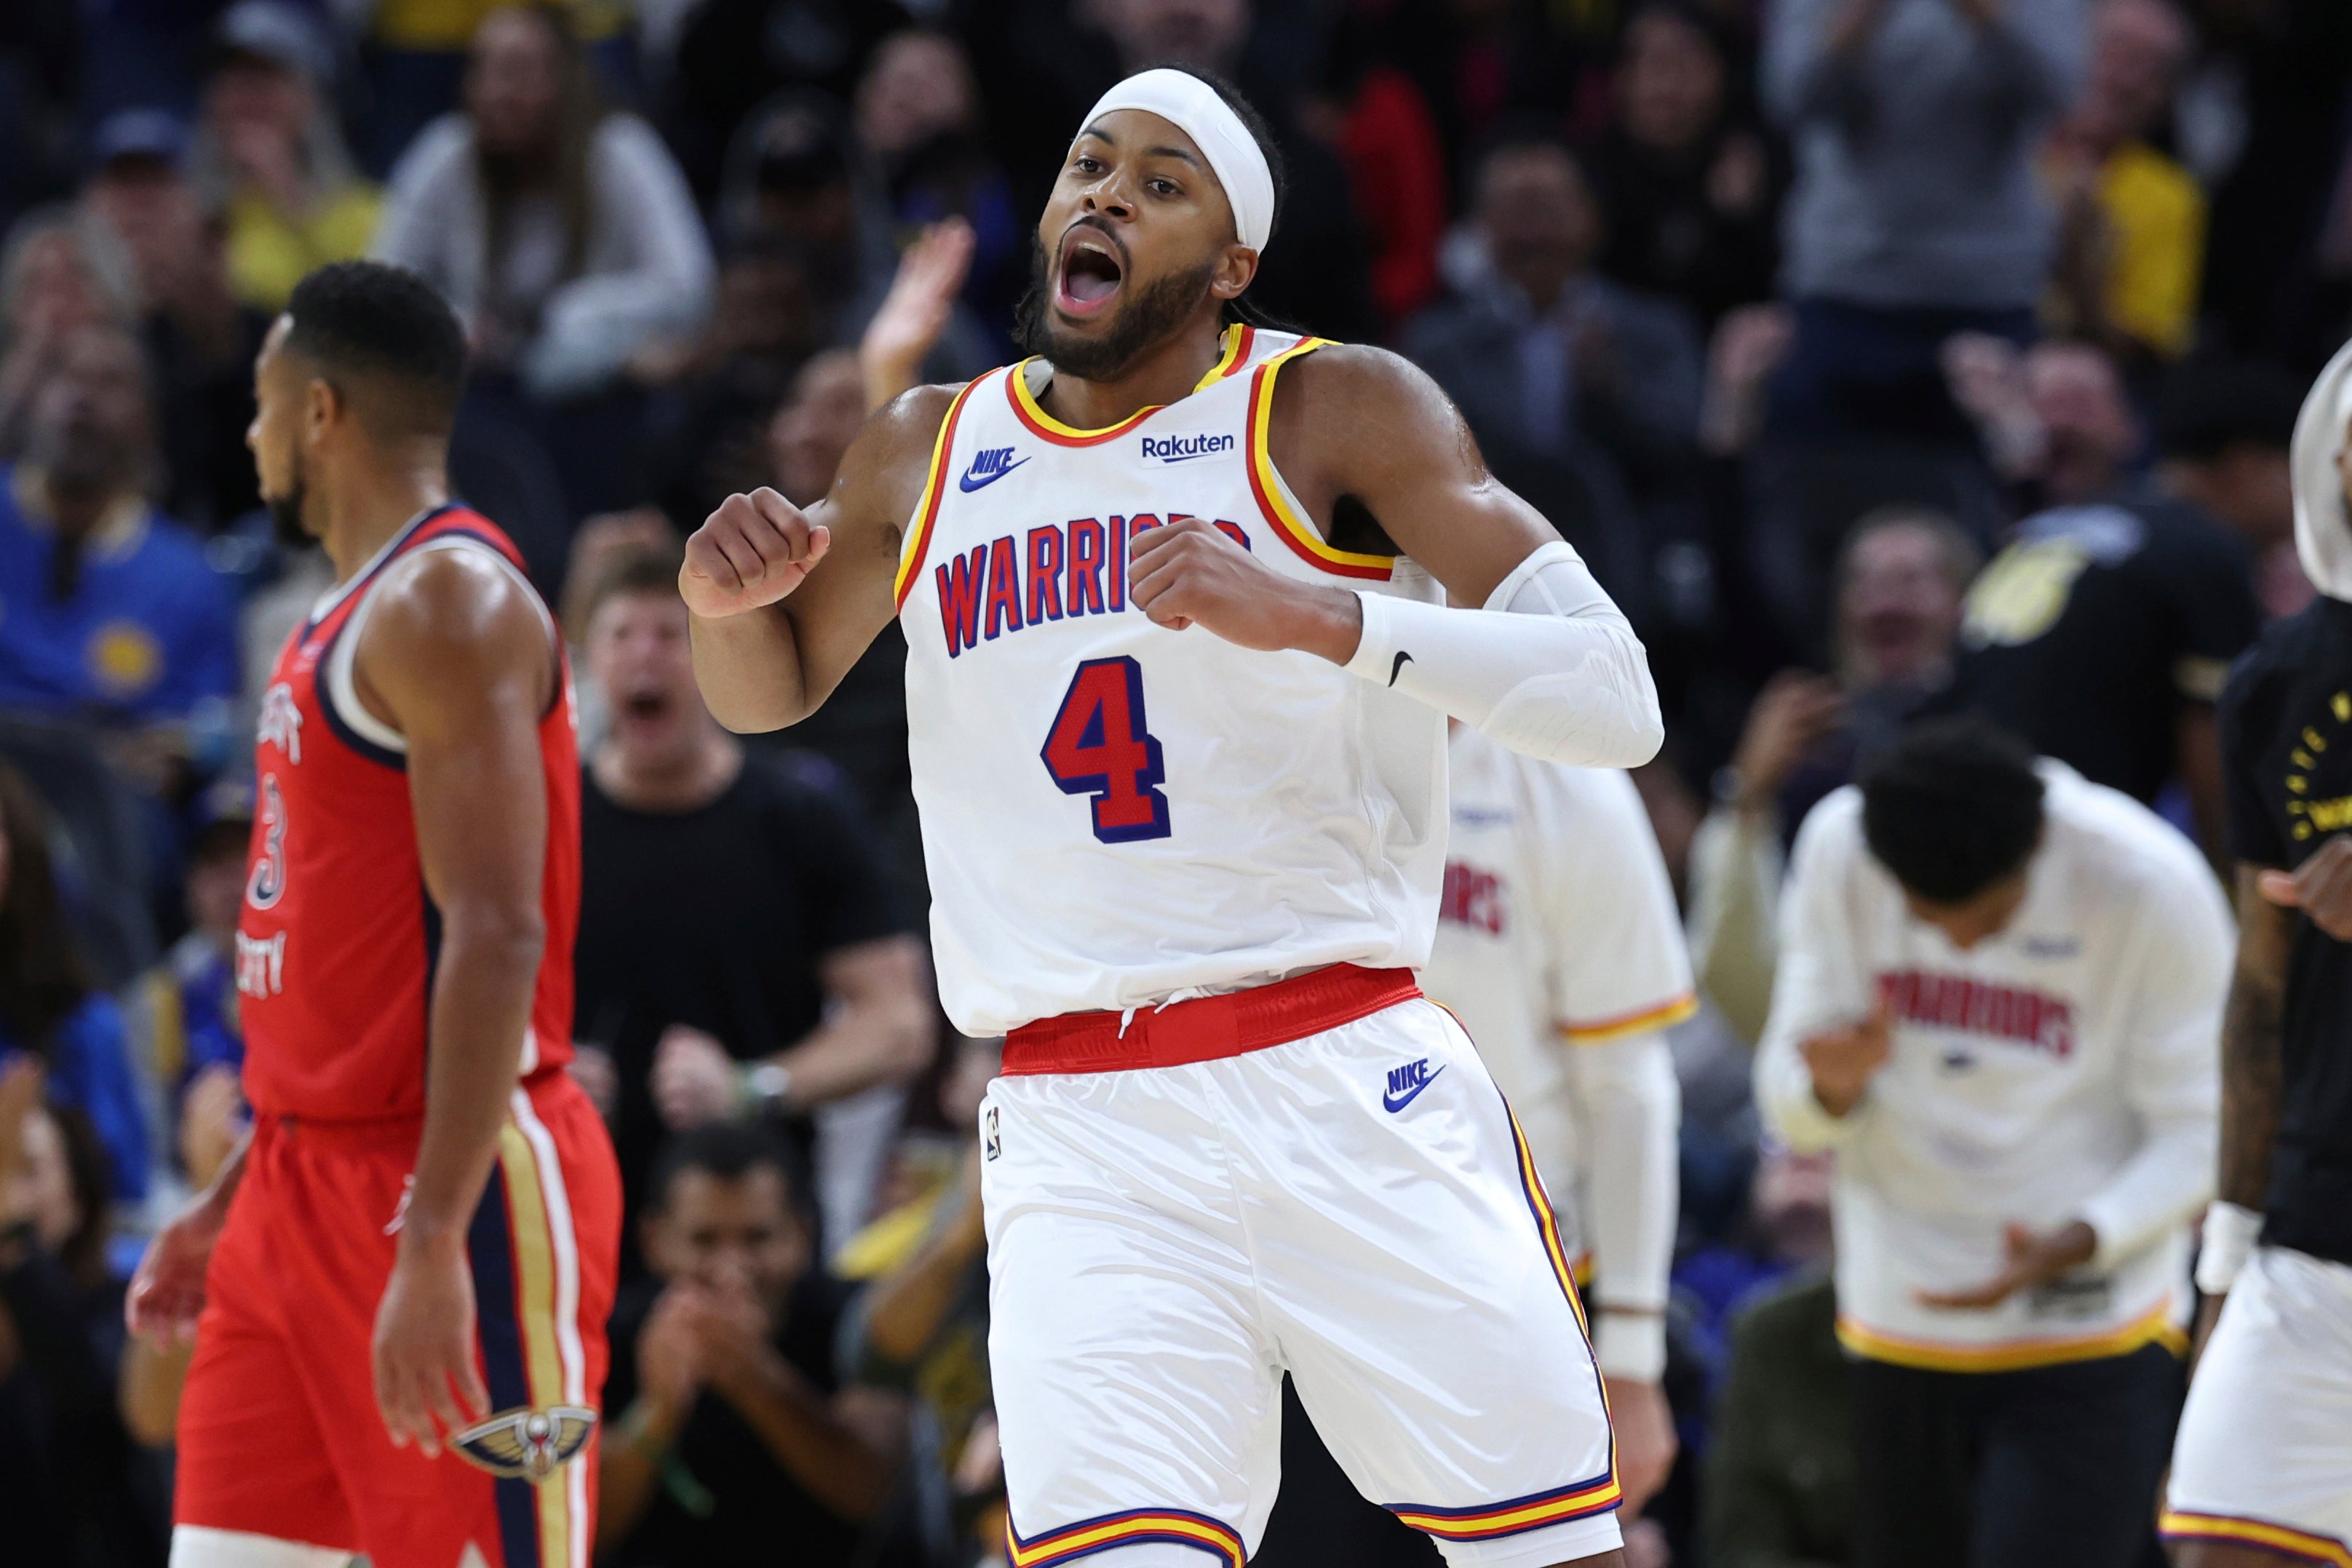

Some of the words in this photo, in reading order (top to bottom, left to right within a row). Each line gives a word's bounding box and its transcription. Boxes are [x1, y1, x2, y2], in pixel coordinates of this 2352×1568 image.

[970, 446, 1015, 474] NIKE
[1142, 434, 1234, 458] Rakuten
[935, 513, 1251, 659] WARRI
[1040, 654, 1172, 844] 4
[247, 772, 287, 910] 3
[1387, 1057, 1429, 1094] NIKE
